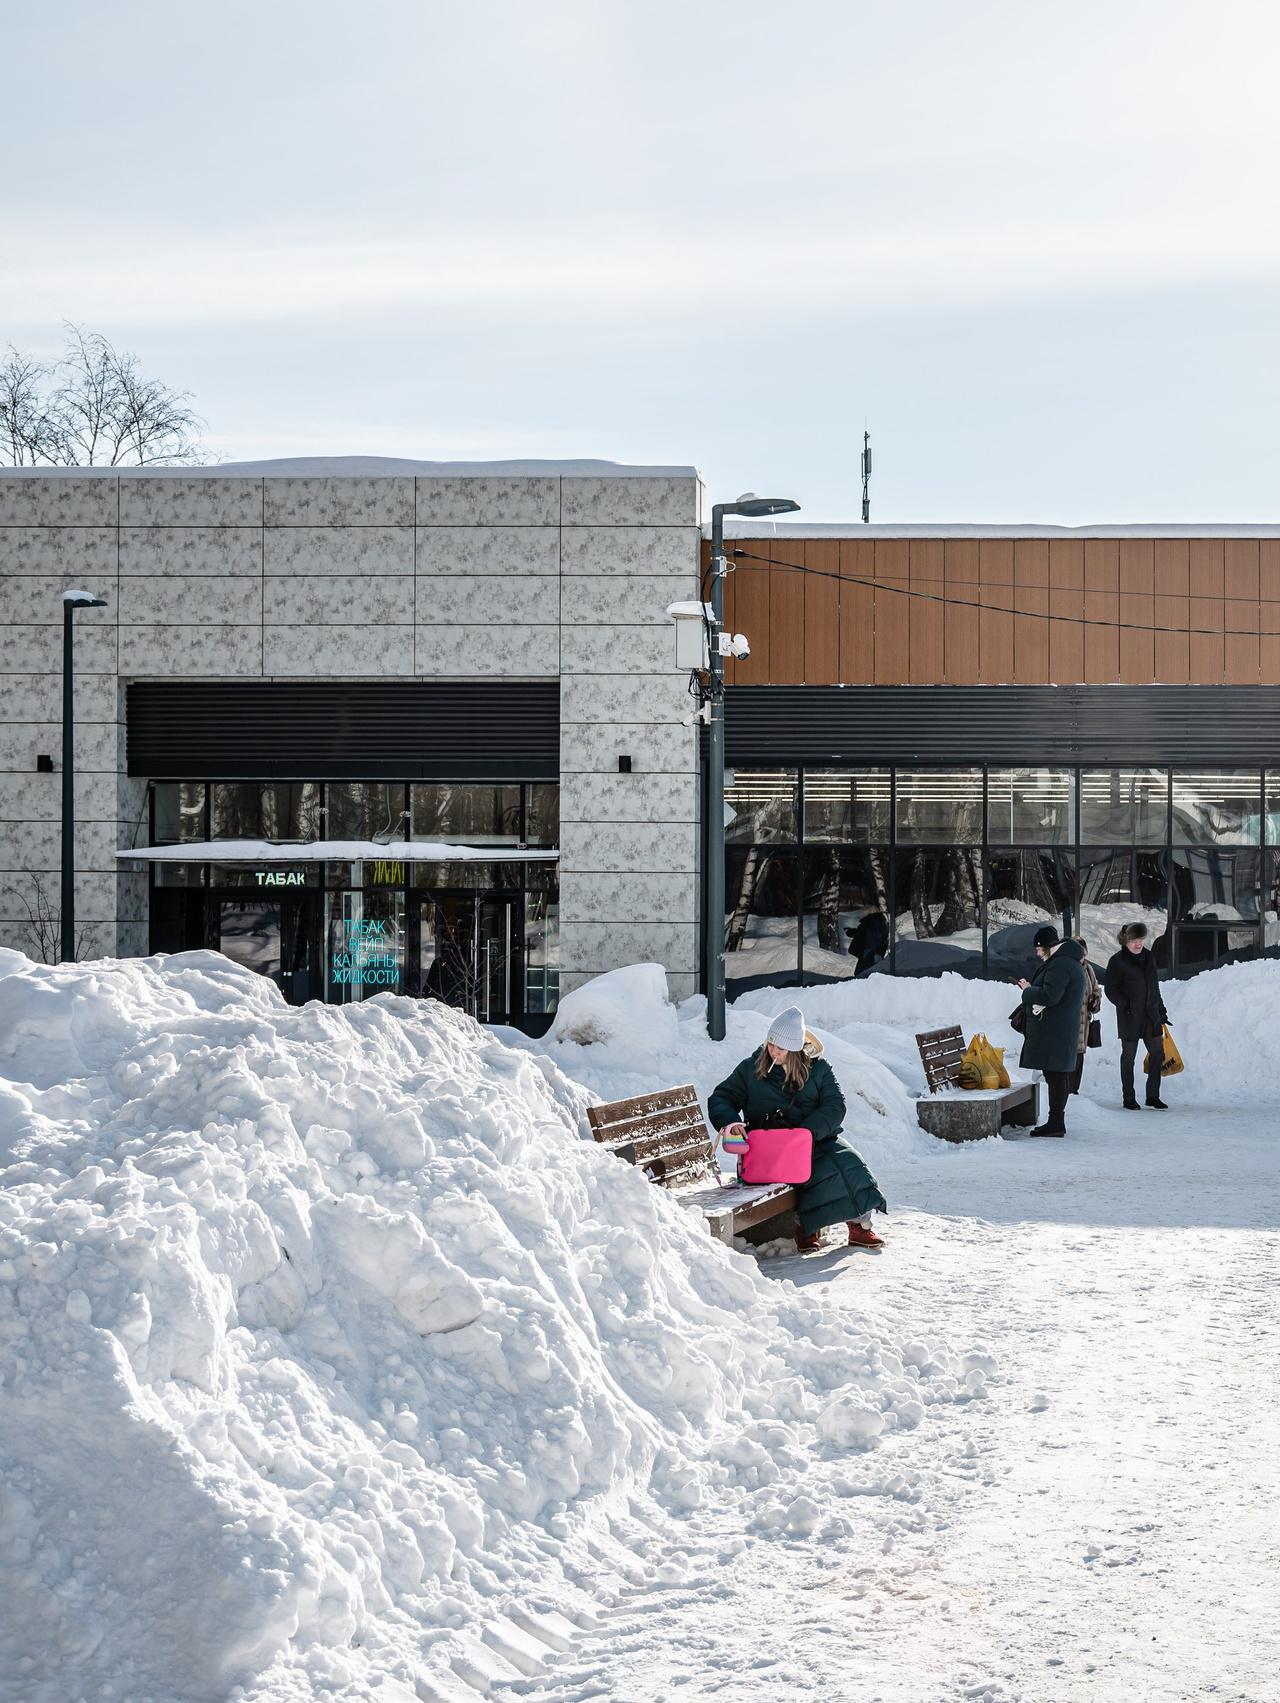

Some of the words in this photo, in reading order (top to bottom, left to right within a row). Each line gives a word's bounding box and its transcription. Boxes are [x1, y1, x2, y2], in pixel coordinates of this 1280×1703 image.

[255, 872, 305, 886] ТАБАК
[344, 919, 386, 934] ТАБАК
[349, 935, 384, 952] ВЕЙП
[333, 953, 397, 968] КАЛЬЯНЫ
[332, 970, 399, 984] ЖИДКОСТИ
